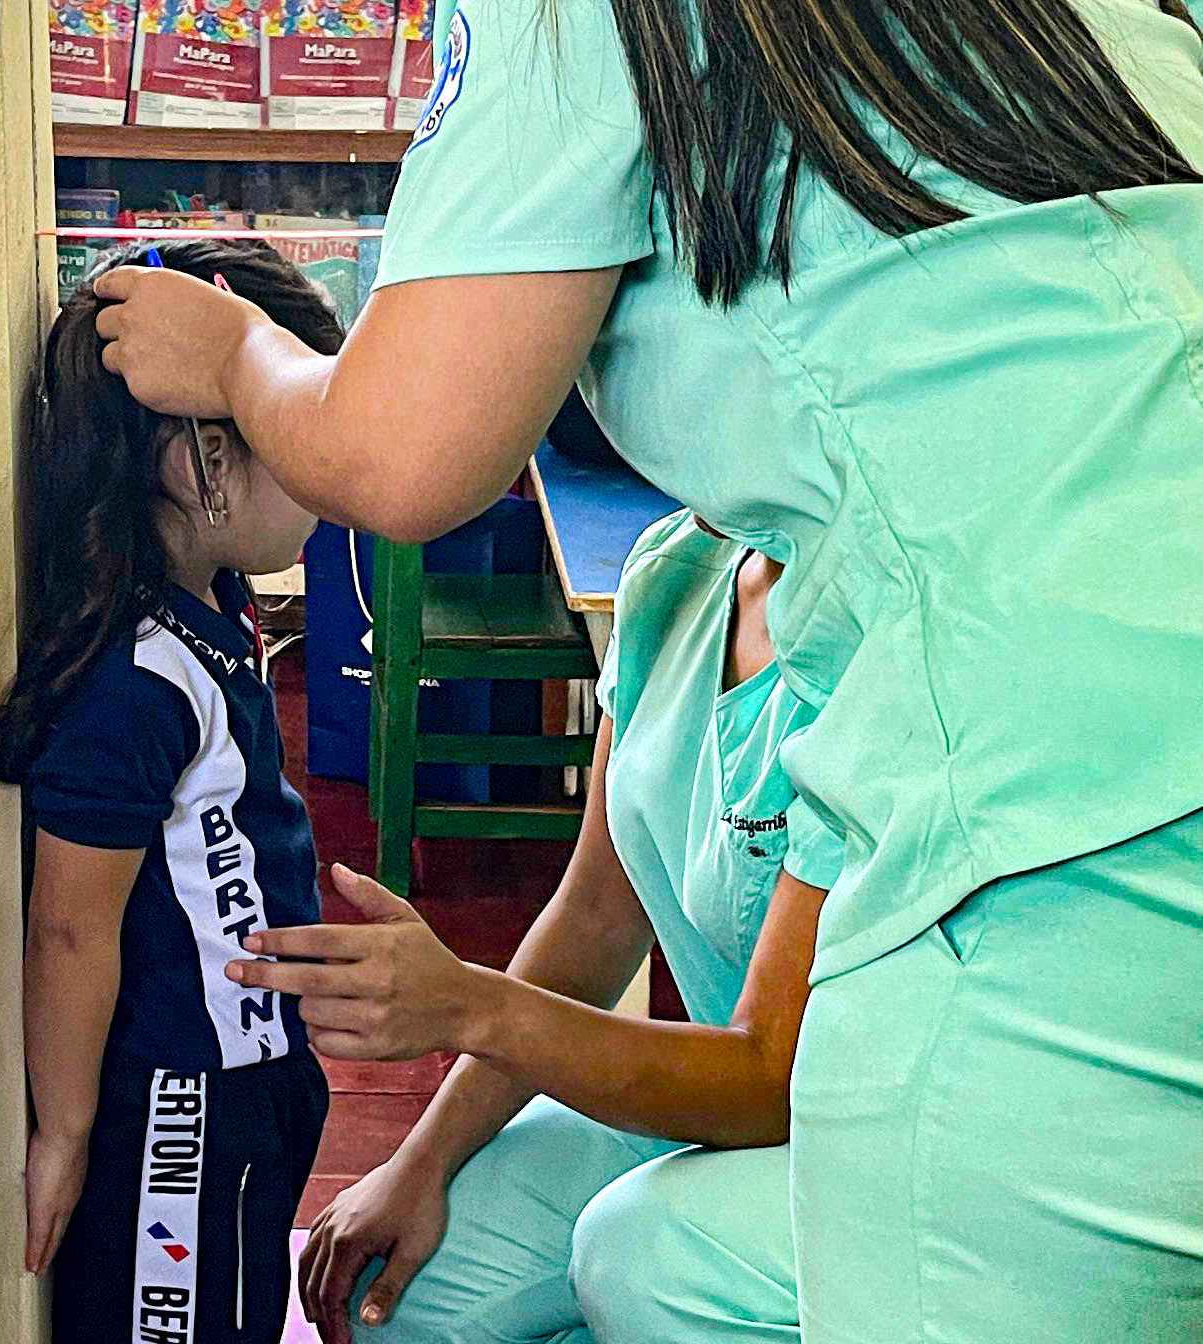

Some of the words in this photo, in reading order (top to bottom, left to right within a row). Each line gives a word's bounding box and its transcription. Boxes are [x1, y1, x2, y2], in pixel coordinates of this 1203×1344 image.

[179, 44, 231, 64] MaPara
[304, 44, 357, 58] MaPara
[58, 255, 85, 266] ara
[341, 666, 373, 679] SHOP
[199, 804, 279, 1061] BERTN
[147, 1070, 202, 1197] ERTONI
